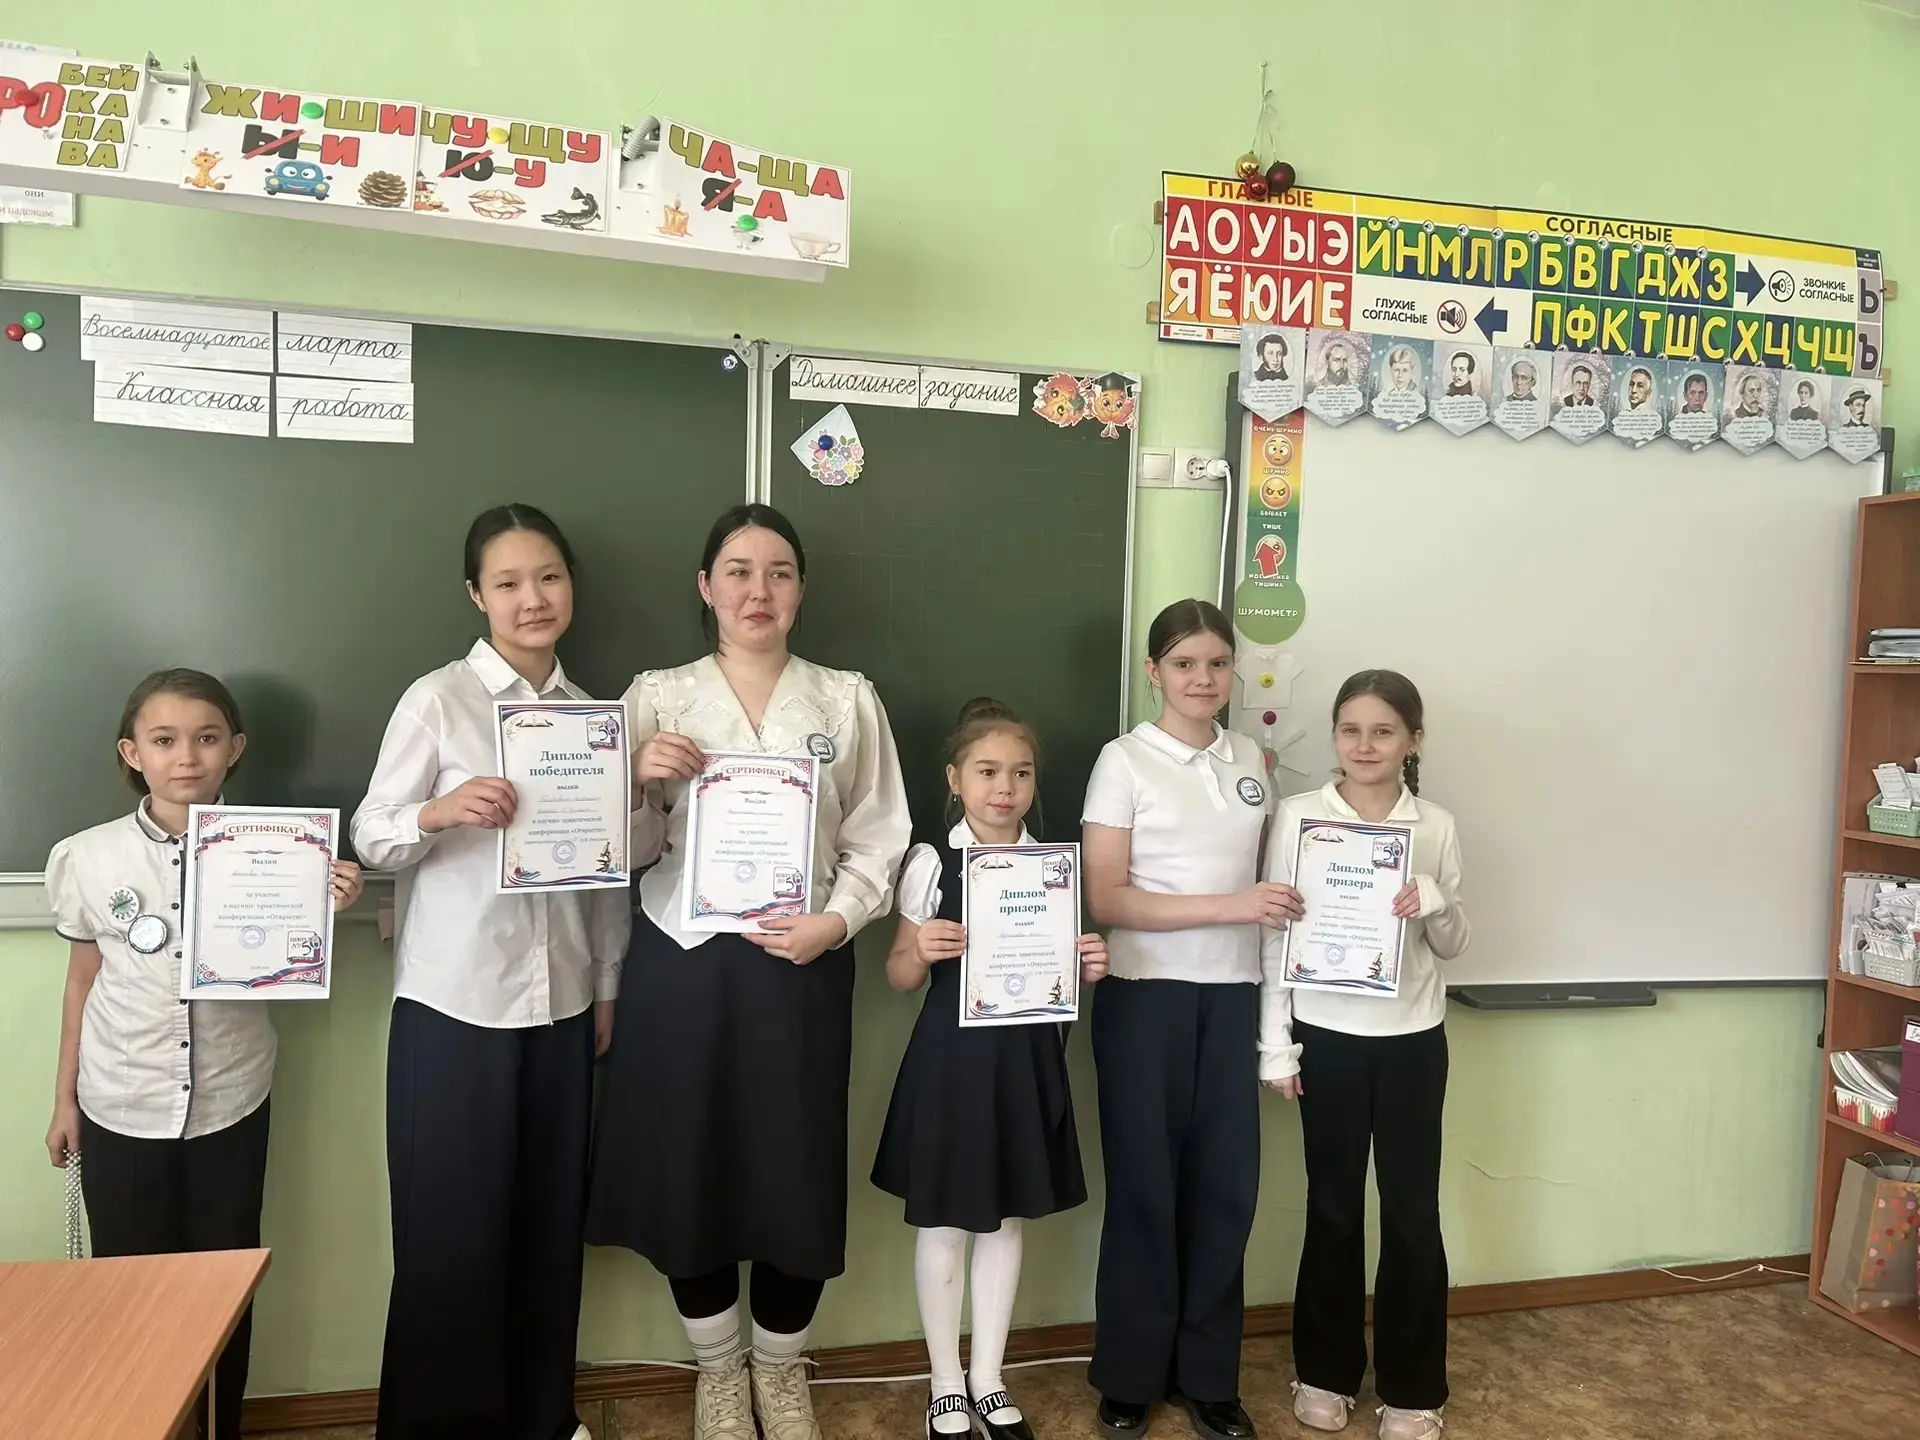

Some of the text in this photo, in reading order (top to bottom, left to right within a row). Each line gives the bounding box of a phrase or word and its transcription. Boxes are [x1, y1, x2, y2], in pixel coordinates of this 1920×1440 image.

[58, 63, 139, 91] БЕЙ
[66, 89, 128, 117] КА
[62, 115, 124, 143] НА
[57, 141, 118, 168] ВА
[669, 124, 844, 200] ЧА-ЩА
[24, 190, 44, 198] они
[1208, 180, 1313, 207] ГЛАНЫЕ
[1545, 216, 1673, 243] СОГЛАСНЫЕ
[1803, 277, 1846, 291] ЗВОНКИЕ
[1799, 288, 1855, 304] СОГЛАСНЫЕ
[1375, 297, 1416, 312] ГЛУХИЕ
[1362, 309, 1428, 325] СОГЛАСНЫЕ
[83, 313, 402, 366] Восемнадцатое марта
[792, 358, 1018, 408] Домашнее задание
[117, 370, 409, 427] Классная работа
[1253, 425, 1303, 435] ОЧЕНЬ ШУМНО
[1263, 467, 1290, 476] ШУМНО
[1262, 523, 1282, 531] ТИШЕ
[1238, 607, 1298, 617] ШУМОМЕТР
[540, 750, 592, 762] Диплом
[529, 765, 604, 777] победителя
[725, 766, 788, 777] СЕРТИФИКАТ
[228, 825, 300, 835] СЕРТИФИКАТ
[1326, 861, 1375, 876] Диплом
[1325, 876, 1374, 889] призера
[999, 889, 1047, 900] Диплом
[999, 902, 1047, 915] призера
